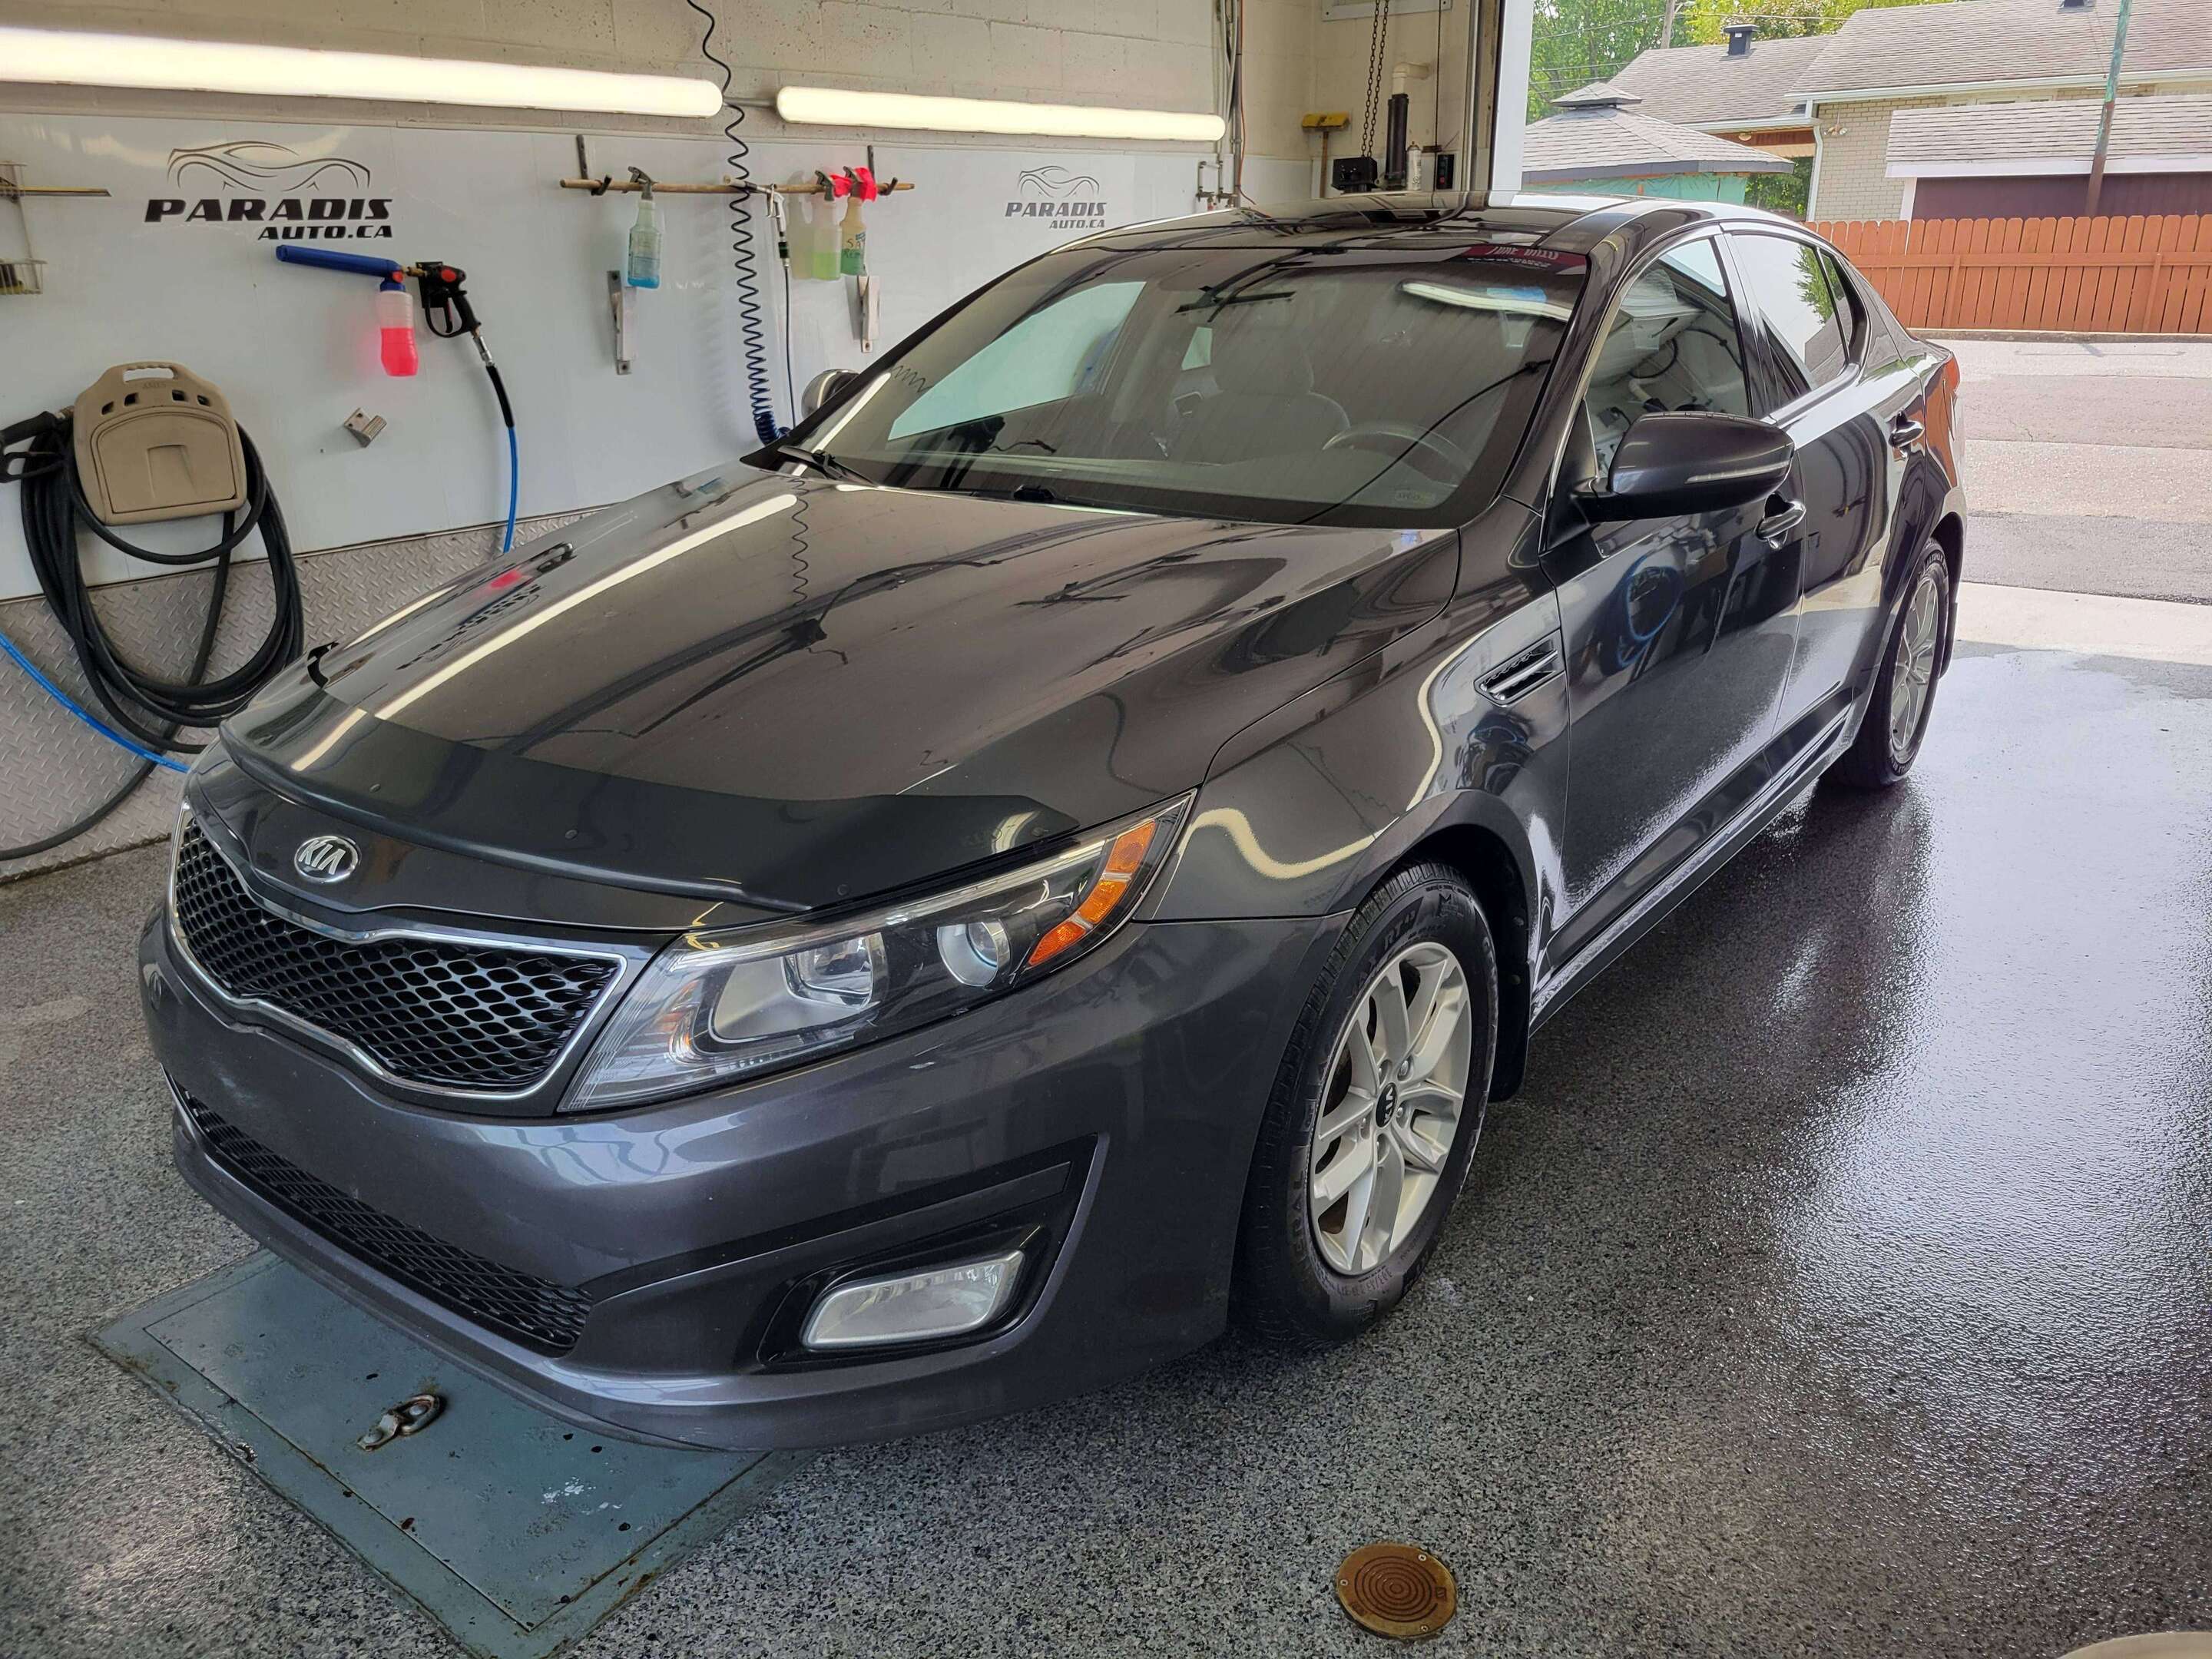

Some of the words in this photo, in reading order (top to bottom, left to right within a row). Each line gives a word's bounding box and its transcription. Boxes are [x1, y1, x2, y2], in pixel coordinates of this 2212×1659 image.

[144, 199, 392, 222] PARADIS
[1005, 202, 1108, 217] PARADIS
[257, 226, 392, 240] AUTO.CA
[1049, 220, 1105, 229] AUTO.CA
[298, 839, 346, 876] KIA
[1383, 1086, 1393, 1124] KIA
